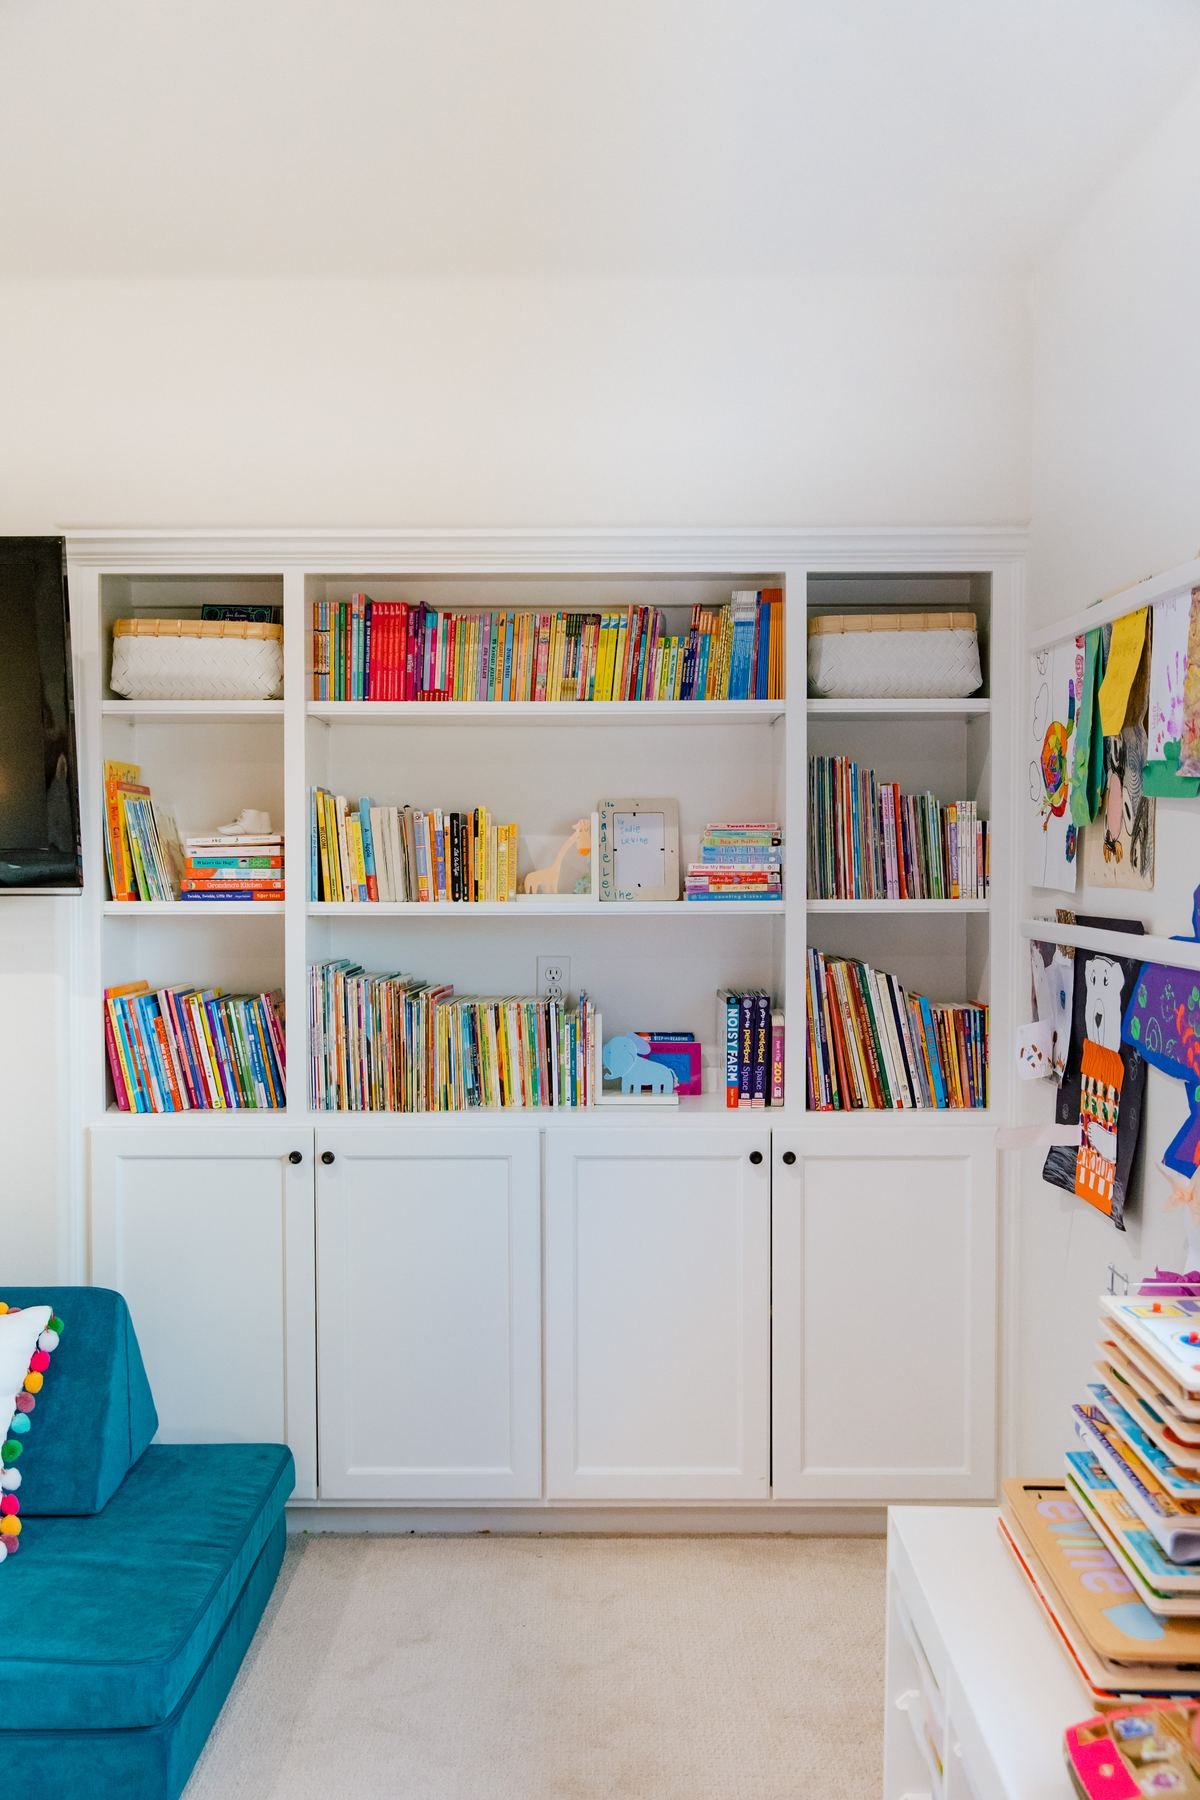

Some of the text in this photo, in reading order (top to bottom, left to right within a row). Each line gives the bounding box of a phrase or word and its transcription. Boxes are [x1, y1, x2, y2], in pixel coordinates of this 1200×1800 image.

[728, 1009, 738, 1081] NOISY FARM
[741, 1066, 750, 1090] Space
[756, 1066, 764, 1090] Space
[774, 1062, 782, 1083] ZOO
